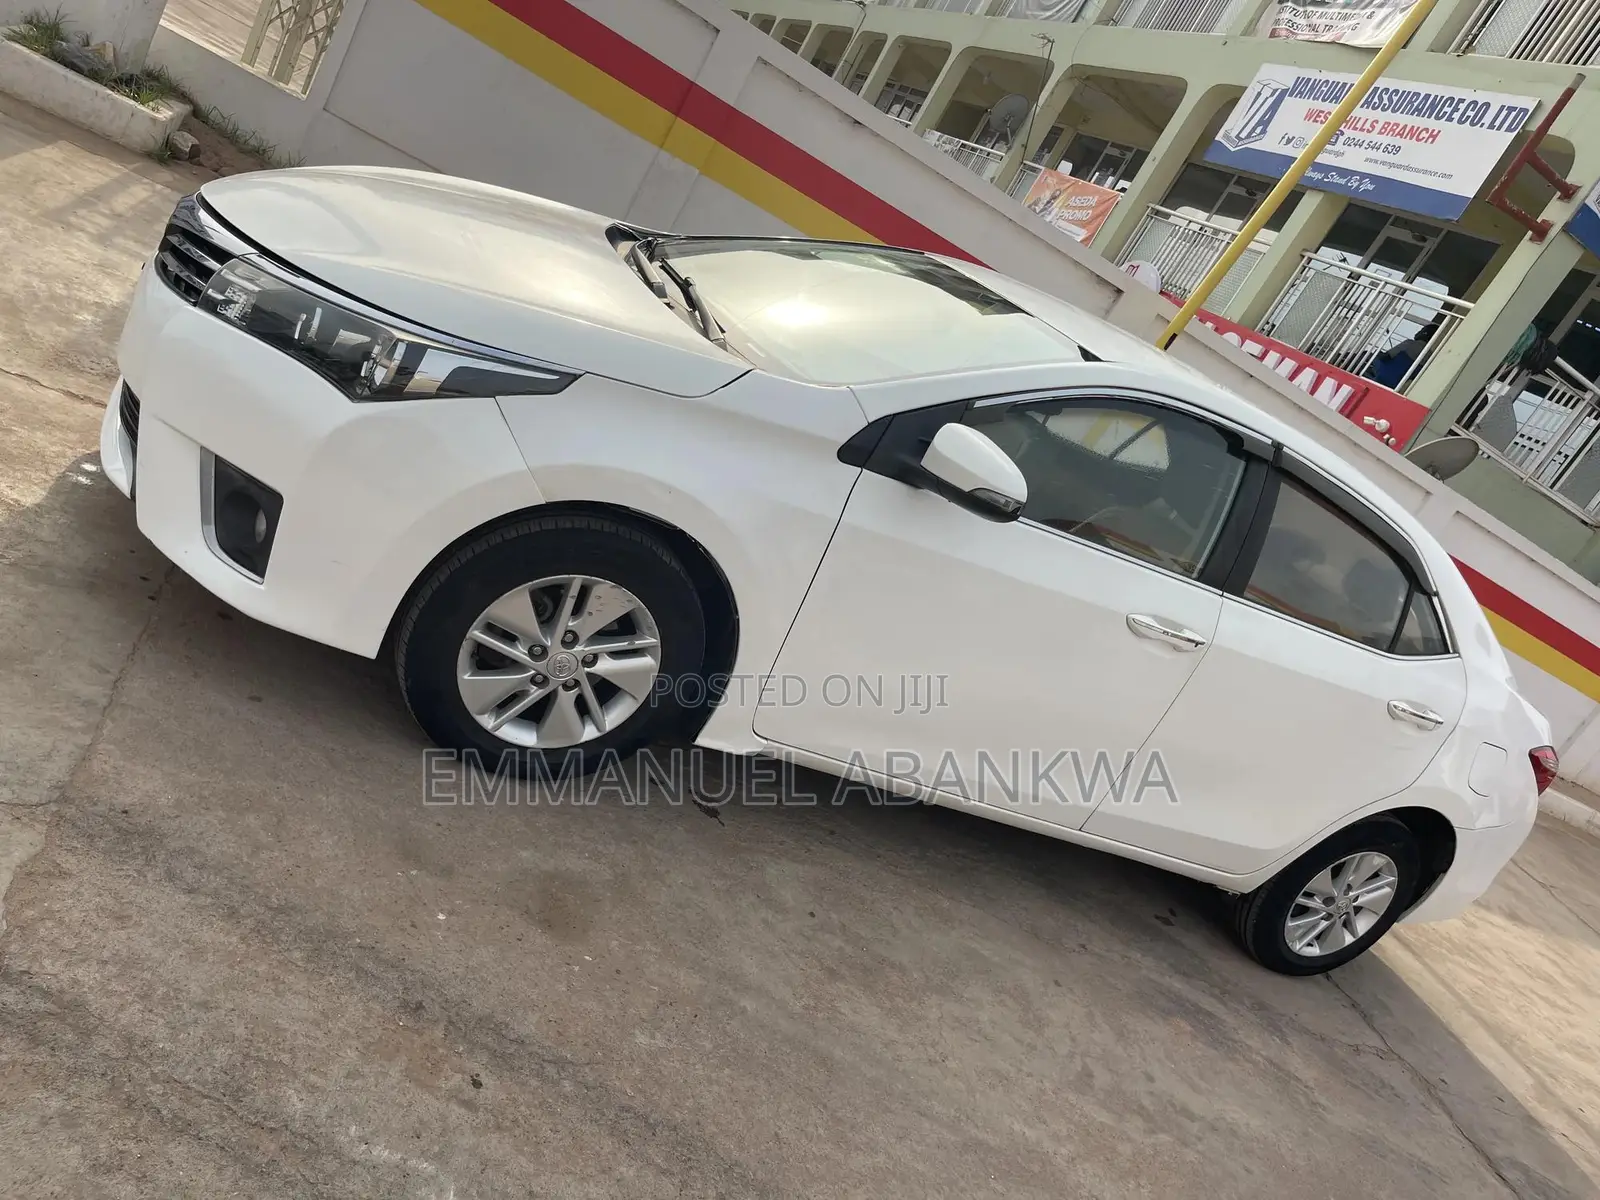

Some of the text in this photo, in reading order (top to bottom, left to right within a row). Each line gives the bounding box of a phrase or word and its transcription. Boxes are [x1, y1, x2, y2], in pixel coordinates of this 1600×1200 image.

[1317, 10, 1368, 21] MULTIMEA
[1287, 76, 1530, 133] VANGUA ASSURANCE CO. LTD
[1303, 108, 1441, 144] WES HILLS BRANCH
[1342, 137, 1402, 155] 0244 544 639
[1363, 157, 1454, 180] www.vanguardassurance.com
[1324, 172, 1351, 185] Stand
[1347, 176, 1360, 190] By
[1358, 178, 1377, 192] You
[1056, 209, 1093, 222] PROMO
